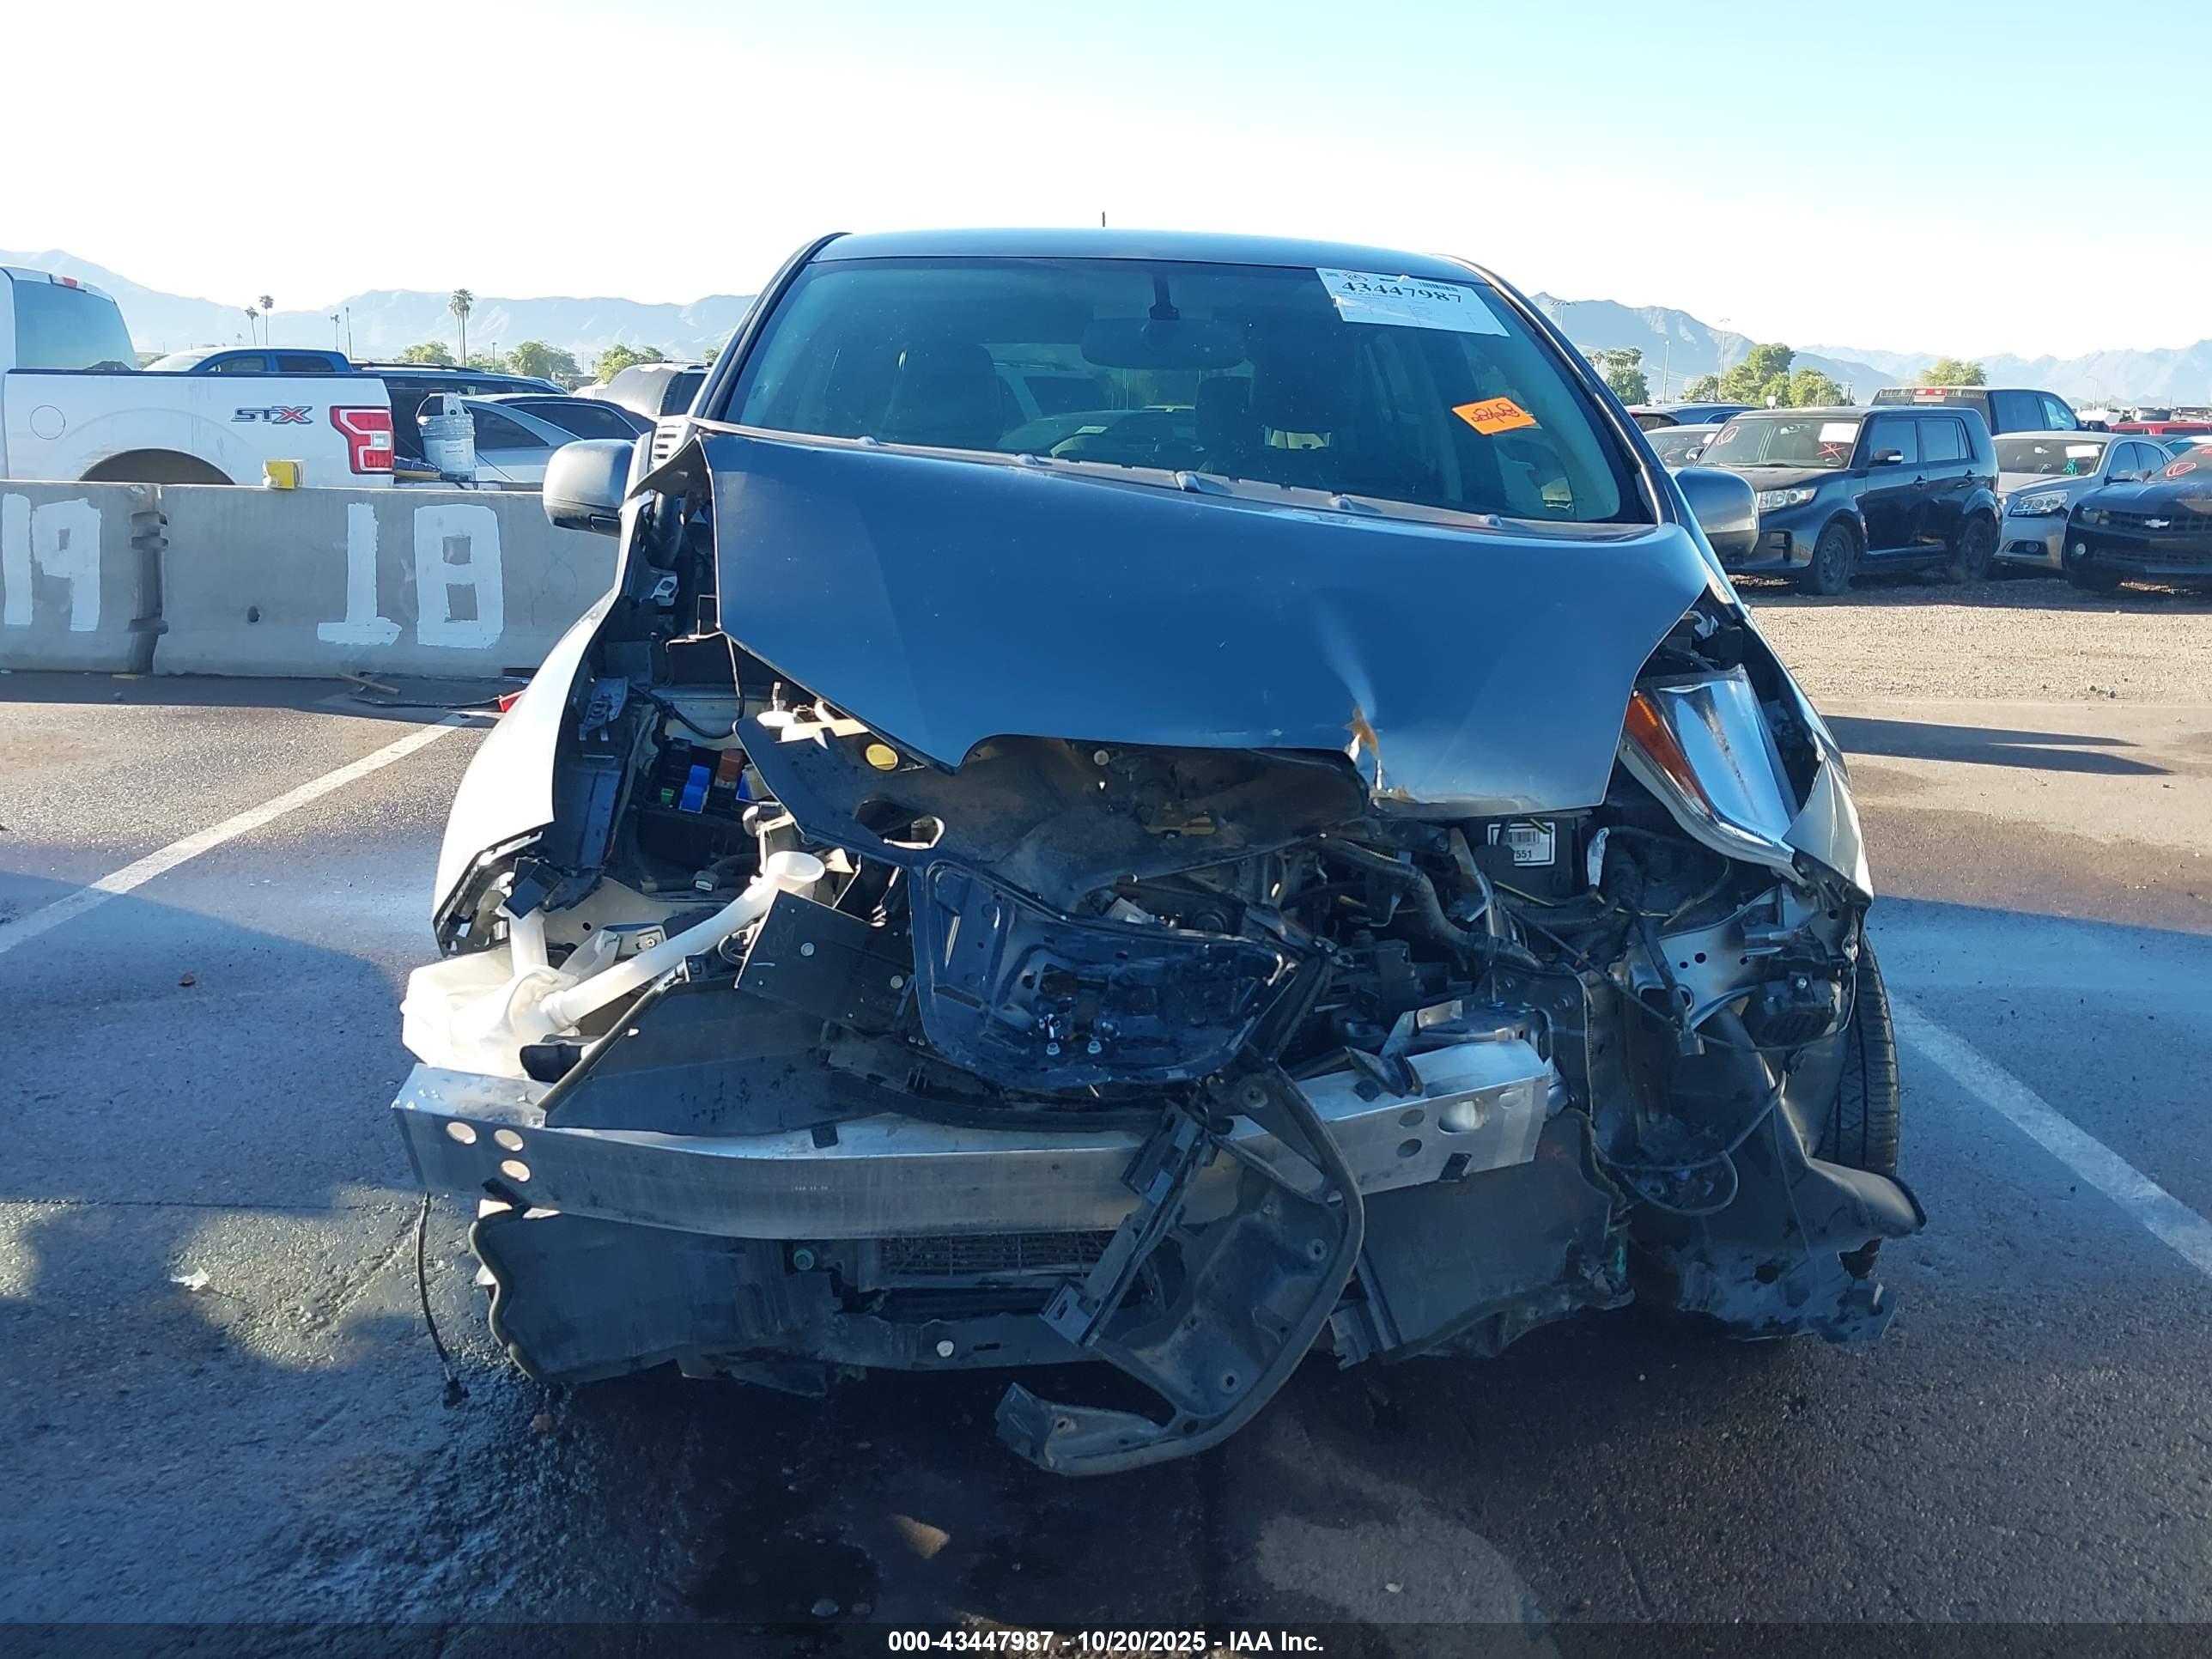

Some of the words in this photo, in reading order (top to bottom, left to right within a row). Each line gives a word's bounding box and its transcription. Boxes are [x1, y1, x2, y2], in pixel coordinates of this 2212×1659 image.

[1341, 280, 1462, 303] 43447987
[230, 405, 314, 425] STX
[2, 492, 102, 632] 19
[317, 502, 505, 649] 18
